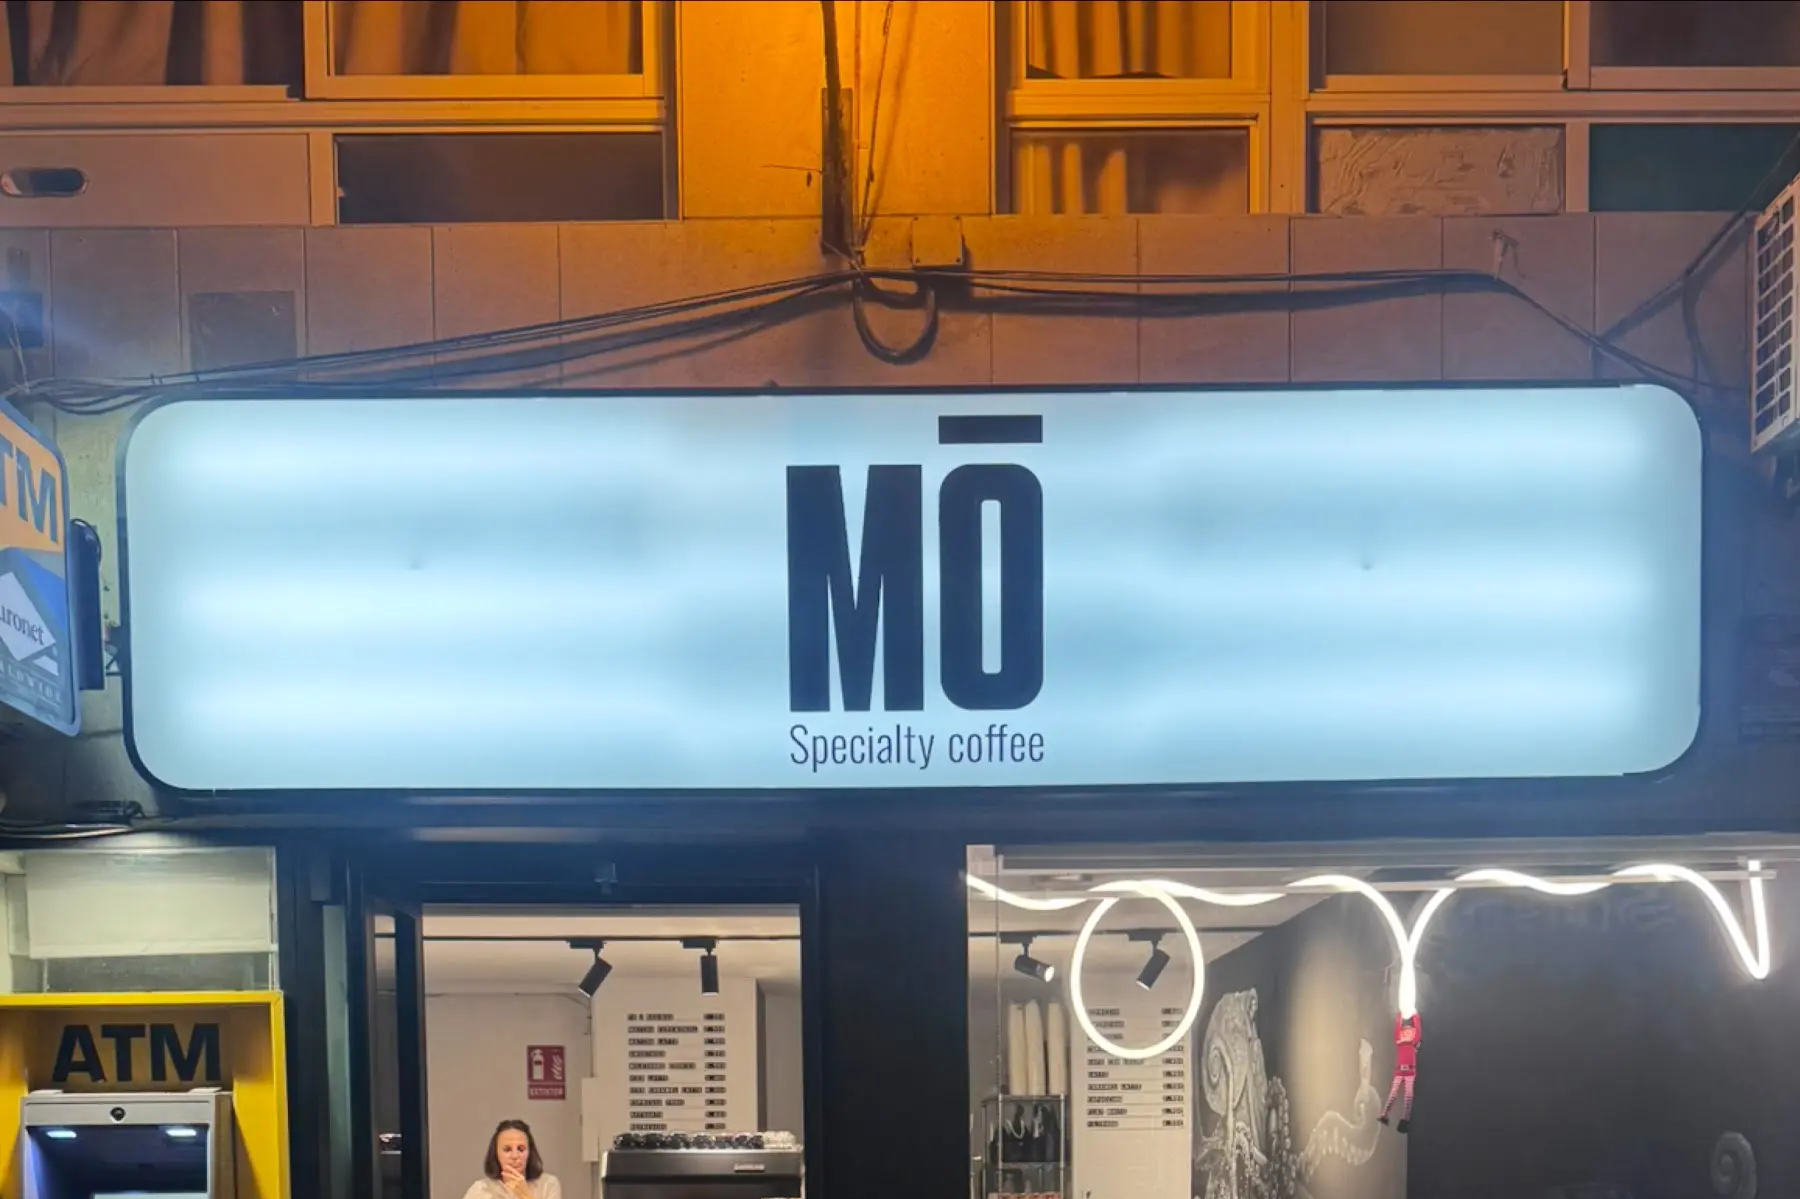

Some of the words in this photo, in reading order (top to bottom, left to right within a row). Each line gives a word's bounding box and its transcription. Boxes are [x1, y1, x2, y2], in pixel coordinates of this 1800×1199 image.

[790, 724, 935, 773] Specialty
[949, 724, 1045, 763] coffee
[52, 1023, 222, 1083] ATM
